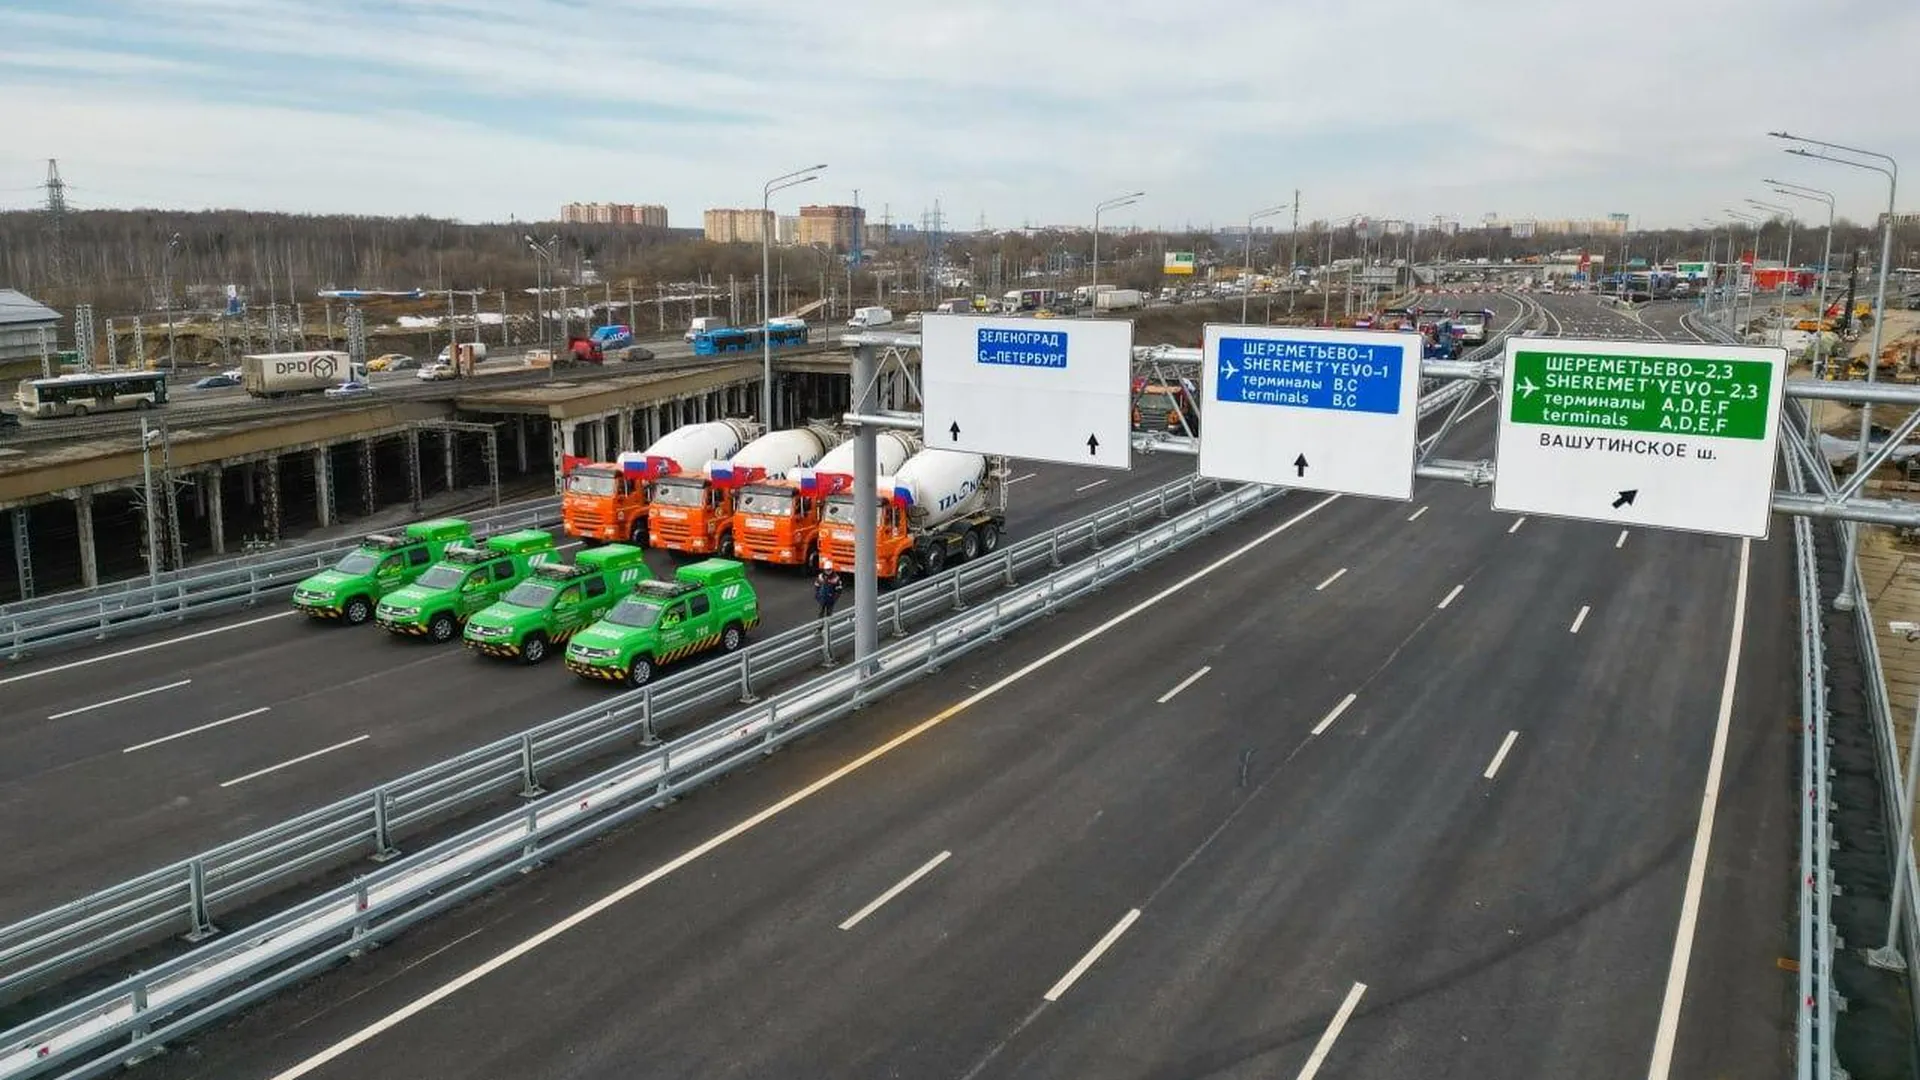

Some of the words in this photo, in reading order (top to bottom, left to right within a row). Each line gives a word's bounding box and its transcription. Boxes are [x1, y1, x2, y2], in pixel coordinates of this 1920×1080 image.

[980, 331, 1059, 347] ЗЕЛЕНОГРАД
[980, 350, 1065, 365] С-ПЕТЕРБУРГ
[1243, 342, 1374, 361] ШЕРЕМЕТЬЕВО-1
[275, 361, 307, 374] DPD
[1242, 357, 1389, 378] SHEREMET'YEVO-1
[1546, 356, 1734, 380] ШЕРЕМЕТЬЕВО-2,3
[1242, 376, 1323, 391] терминалы
[1333, 377, 1358, 393] B,C
[1242, 389, 1309, 404] terminals
[1333, 394, 1357, 409] B,C
[1544, 393, 1646, 410] терминалы
[1661, 397, 1730, 416] A,D,E,F
[1543, 408, 1629, 427] terminals
[1660, 415, 1728, 434] A,D,E,F
[1539, 433, 1687, 458] ВАШУТИНСКОЕ
[1696, 449, 1718, 461] ш.
